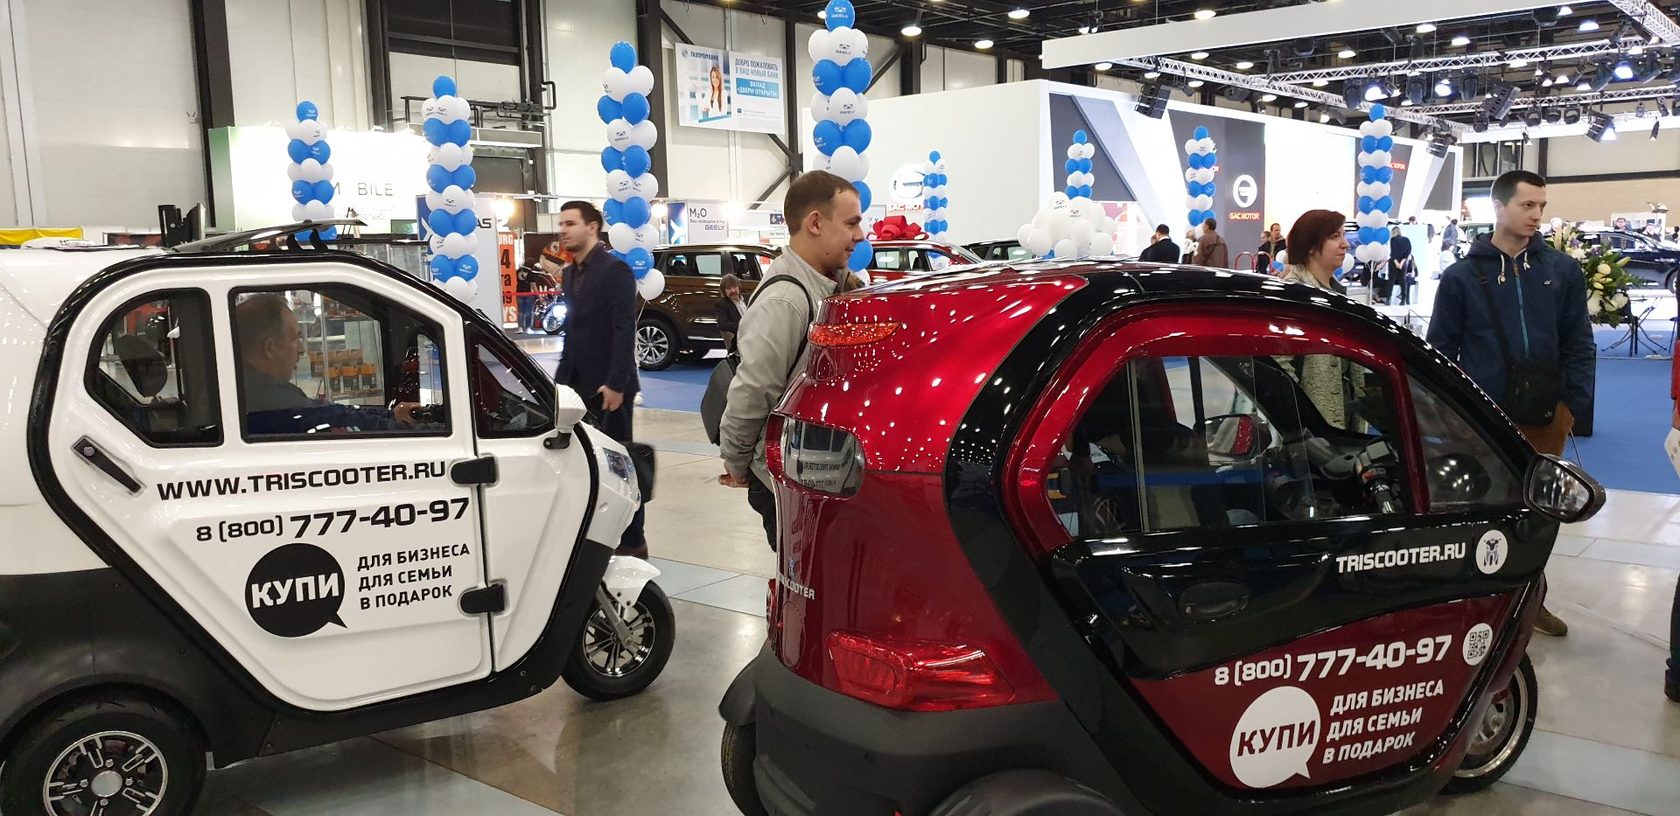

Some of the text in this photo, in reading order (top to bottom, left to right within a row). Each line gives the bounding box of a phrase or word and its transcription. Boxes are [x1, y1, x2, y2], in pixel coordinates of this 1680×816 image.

[735, 58, 778, 71] ДОБРО ПОЖАЛОВАТЬ
[157, 461, 446, 500] WWW.TRISCOOTER.RU
[196, 526, 212, 542] 8
[290, 498, 469, 539] 777-40-97
[357, 543, 470, 572] ДЛЯ БИЗНЕСА
[1336, 542, 1466, 574] TRISCOOTER.RU
[251, 573, 340, 609] КУПИ
[359, 565, 452, 592] ДЛЯ СЕМЬИ
[360, 585, 452, 610] В ПОДАРОК
[1214, 666, 1230, 686] 8
[1297, 635, 1452, 682] 777-40-97
[1330, 679, 1444, 716] ДЛЯ БИЗНЕСА
[1237, 720, 1316, 757] КУПИ
[1326, 707, 1422, 742] ДЛЯ СЕМЬИ
[1322, 732, 1416, 764] В ПОДАРОК
